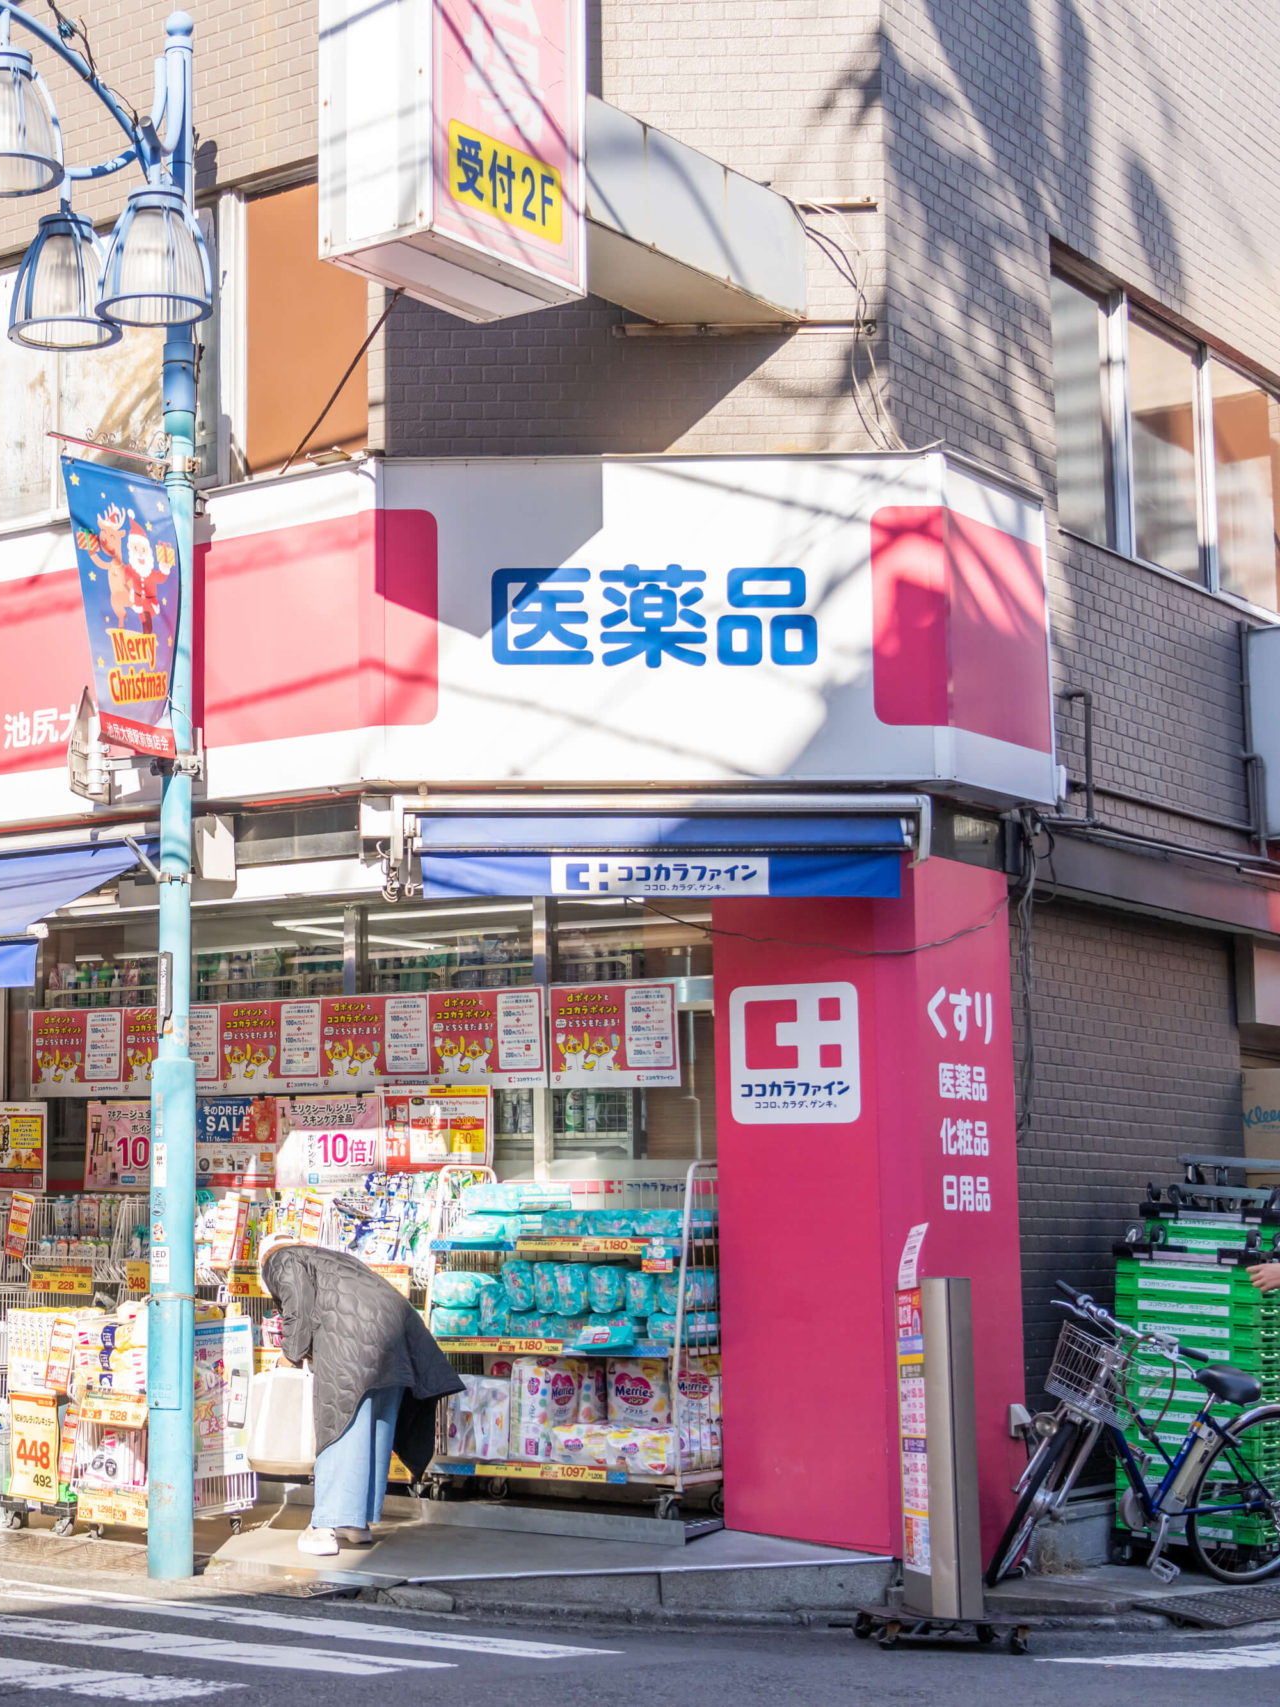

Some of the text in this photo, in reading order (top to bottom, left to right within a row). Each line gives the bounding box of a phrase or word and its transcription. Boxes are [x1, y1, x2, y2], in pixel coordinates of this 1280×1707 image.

[456, 135, 555, 227] 受付2F
[491, 563, 818, 669] 医薬品
[111, 632, 156, 669] Merry
[108, 669, 168, 703] Christmas
[617, 863, 758, 883] ココカラファイン
[927, 986, 993, 1045] くすり
[740, 1080, 850, 1098] ココカラファイン
[938, 1062, 988, 1102] 医薬品
[291, 1102, 366, 1114] エリクシール シリーズ
[1240, 1105, 1280, 1129] Klee
[206, 1116, 251, 1132] SALE
[302, 1114, 353, 1124] スキンケア全品
[940, 1117, 990, 1157] 化粧品
[117, 1136, 150, 1167] 10
[317, 1133, 374, 1164] 10倍!
[943, 1175, 991, 1212] 日用品
[152, 1250, 167, 1258] LED
[58, 1280, 75, 1290] 228
[128, 1277, 146, 1290] 348
[551, 1387, 576, 1400] Merries
[615, 1386, 655, 1399] Merries
[677, 1381, 714, 1393] Merries
[109, 1410, 128, 1422] 528
[16, 1438, 51, 1470] 448
[33, 1473, 52, 1488] 492
